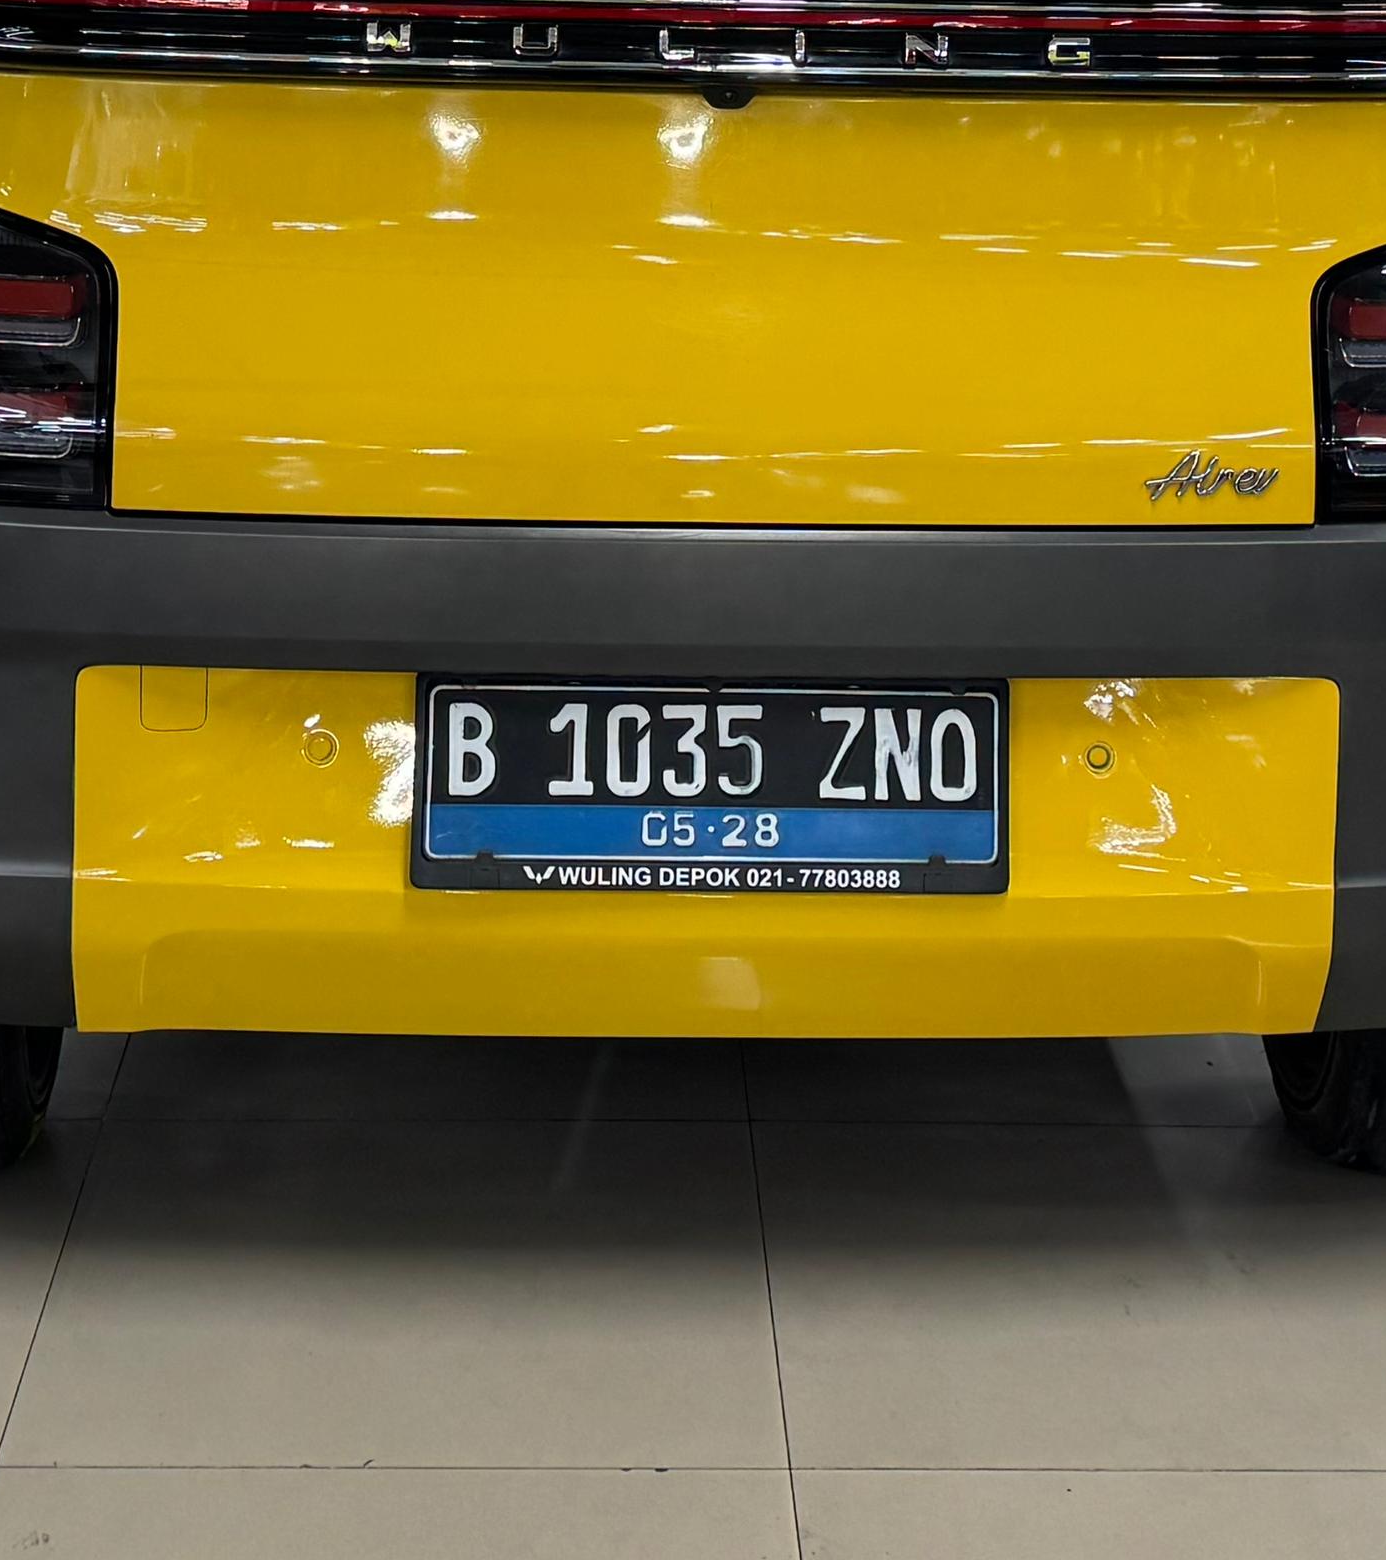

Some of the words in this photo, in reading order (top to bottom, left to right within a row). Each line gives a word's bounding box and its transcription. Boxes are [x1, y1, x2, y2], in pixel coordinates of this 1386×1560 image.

[365, 21, 1092, 68] WULING
[447, 701, 498, 797] B
[547, 702, 764, 798] 1035
[558, 866, 653, 888] WULING
[658, 866, 741, 889] DEPOK
